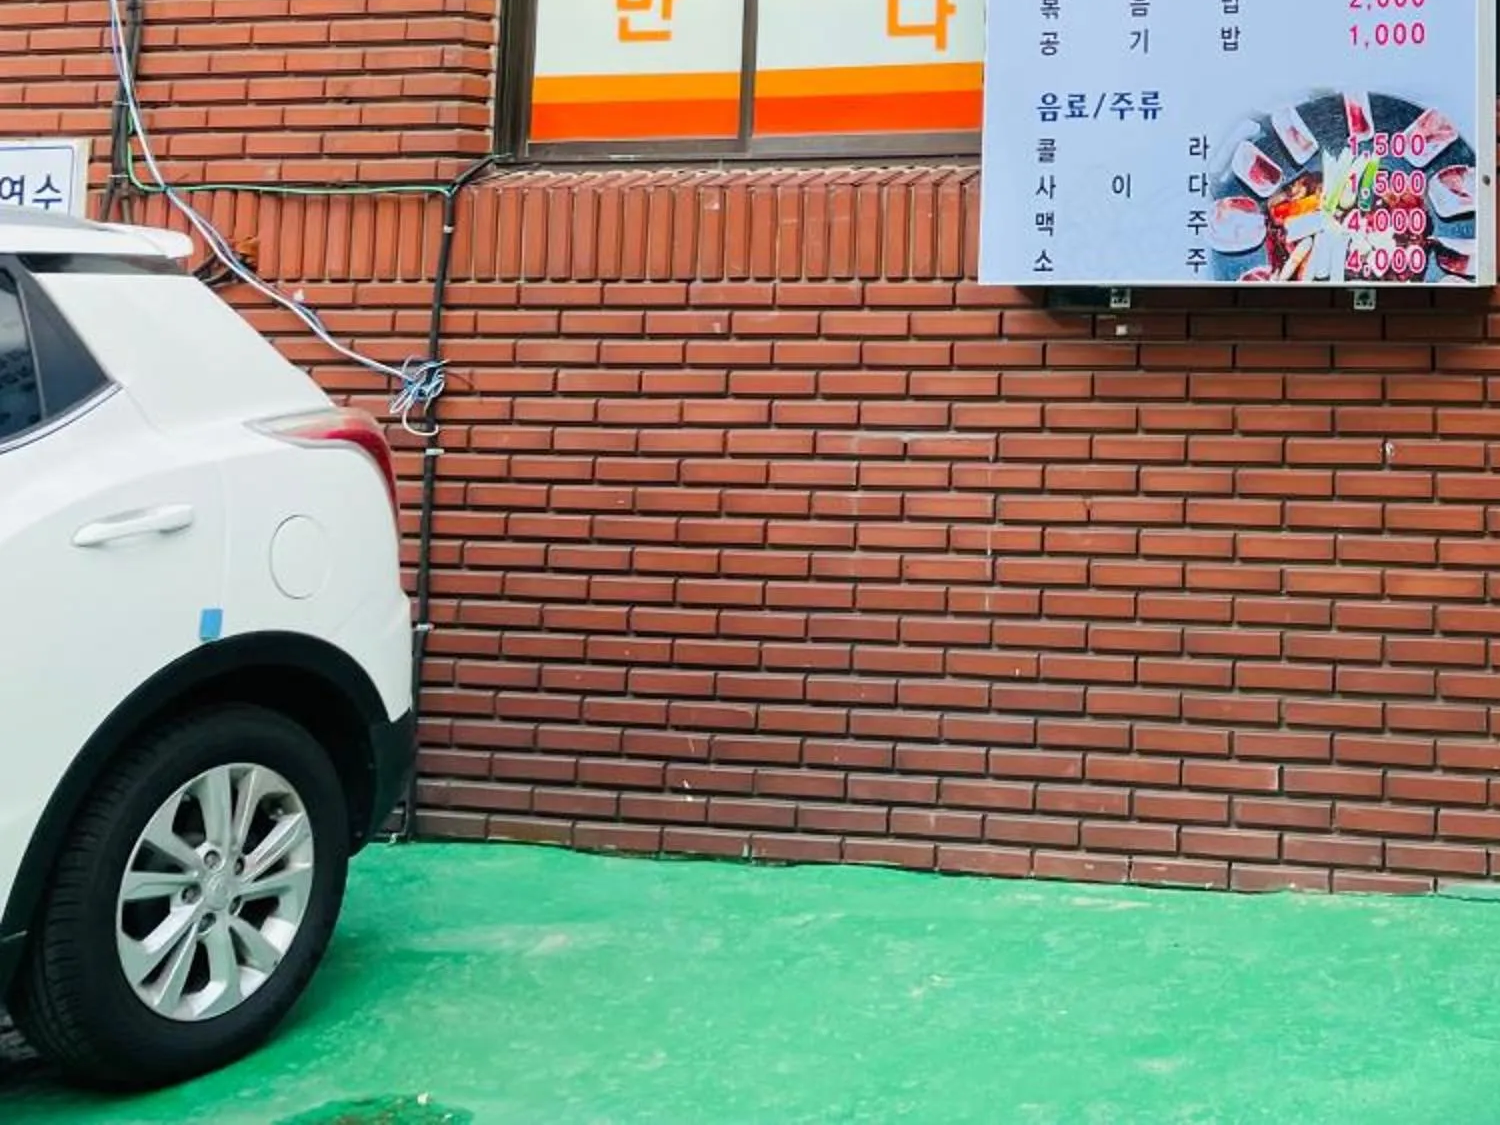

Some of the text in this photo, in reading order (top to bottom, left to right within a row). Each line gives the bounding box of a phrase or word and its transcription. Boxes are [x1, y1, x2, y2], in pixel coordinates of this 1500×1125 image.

[1039, 22, 1426, 57] 공기밥 1,000
[1036, 90, 1164, 123] 음료/주류
[1347, 133, 1426, 160] 1,500
[0, 174, 63, 211] 여수
[1035, 171, 1426, 199] 사이다 1,500
[1347, 208, 1426, 235] 4,000
[1346, 246, 1426, 273] 4,000
